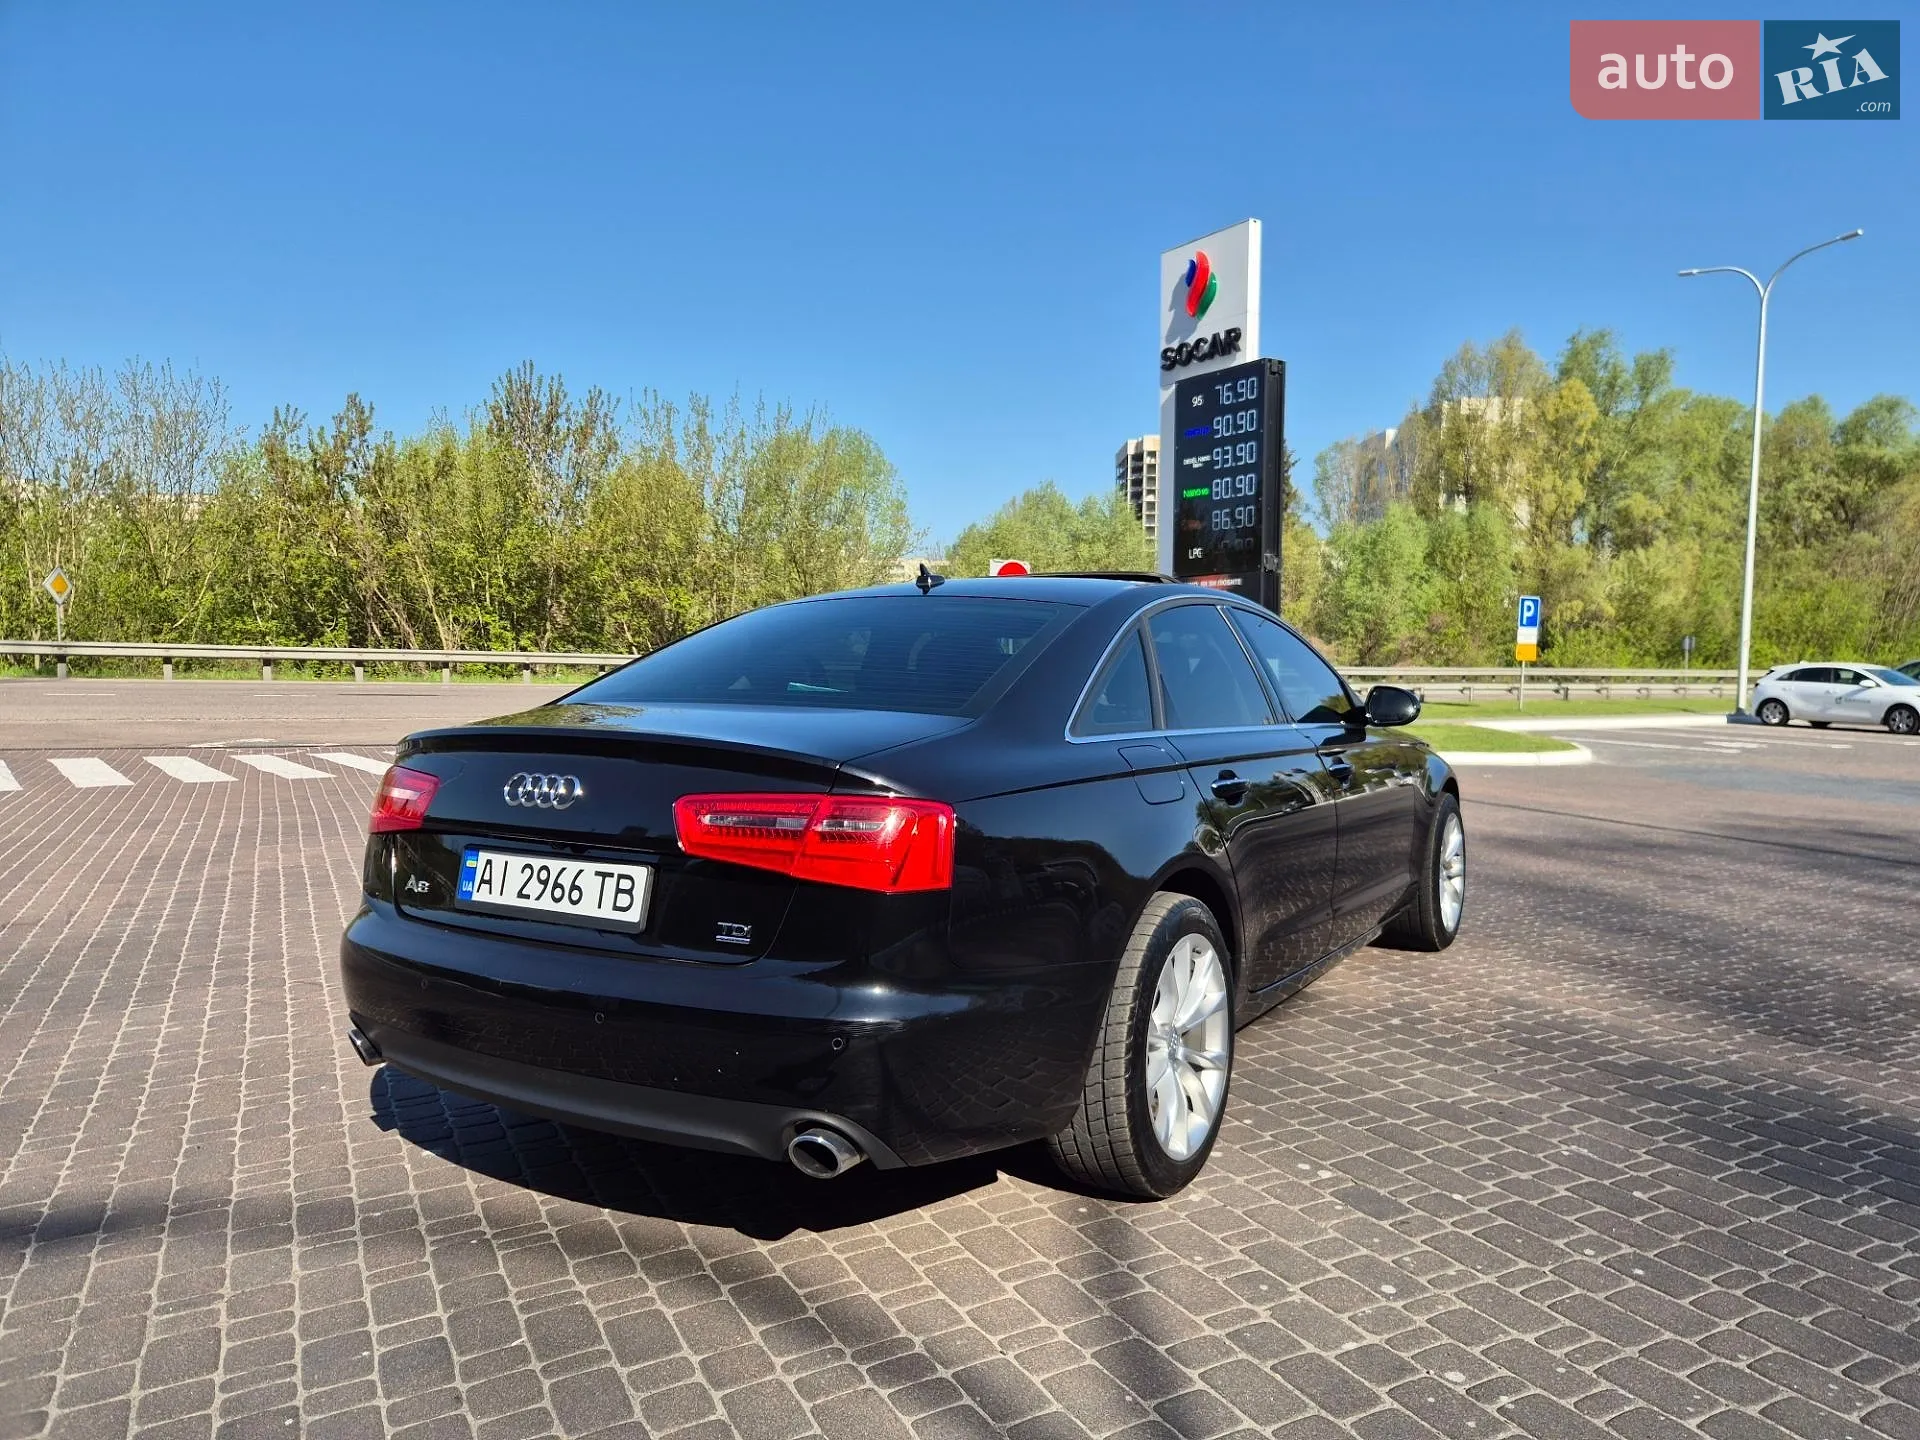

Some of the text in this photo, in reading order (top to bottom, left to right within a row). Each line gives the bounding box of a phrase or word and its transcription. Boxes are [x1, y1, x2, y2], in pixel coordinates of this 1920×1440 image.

[1160, 327, 1242, 371] SOCAR
[1214, 377, 1257, 405] 76.90
[1213, 409, 1257, 439] 90.90
[1212, 441, 1256, 470] 93.90
[1212, 473, 1256, 500] 80.90
[1211, 505, 1255, 531] 86.90
[1522, 599, 1535, 625] P
[462, 880, 473, 892] UA
[476, 858, 636, 913] AI 2966 TB
